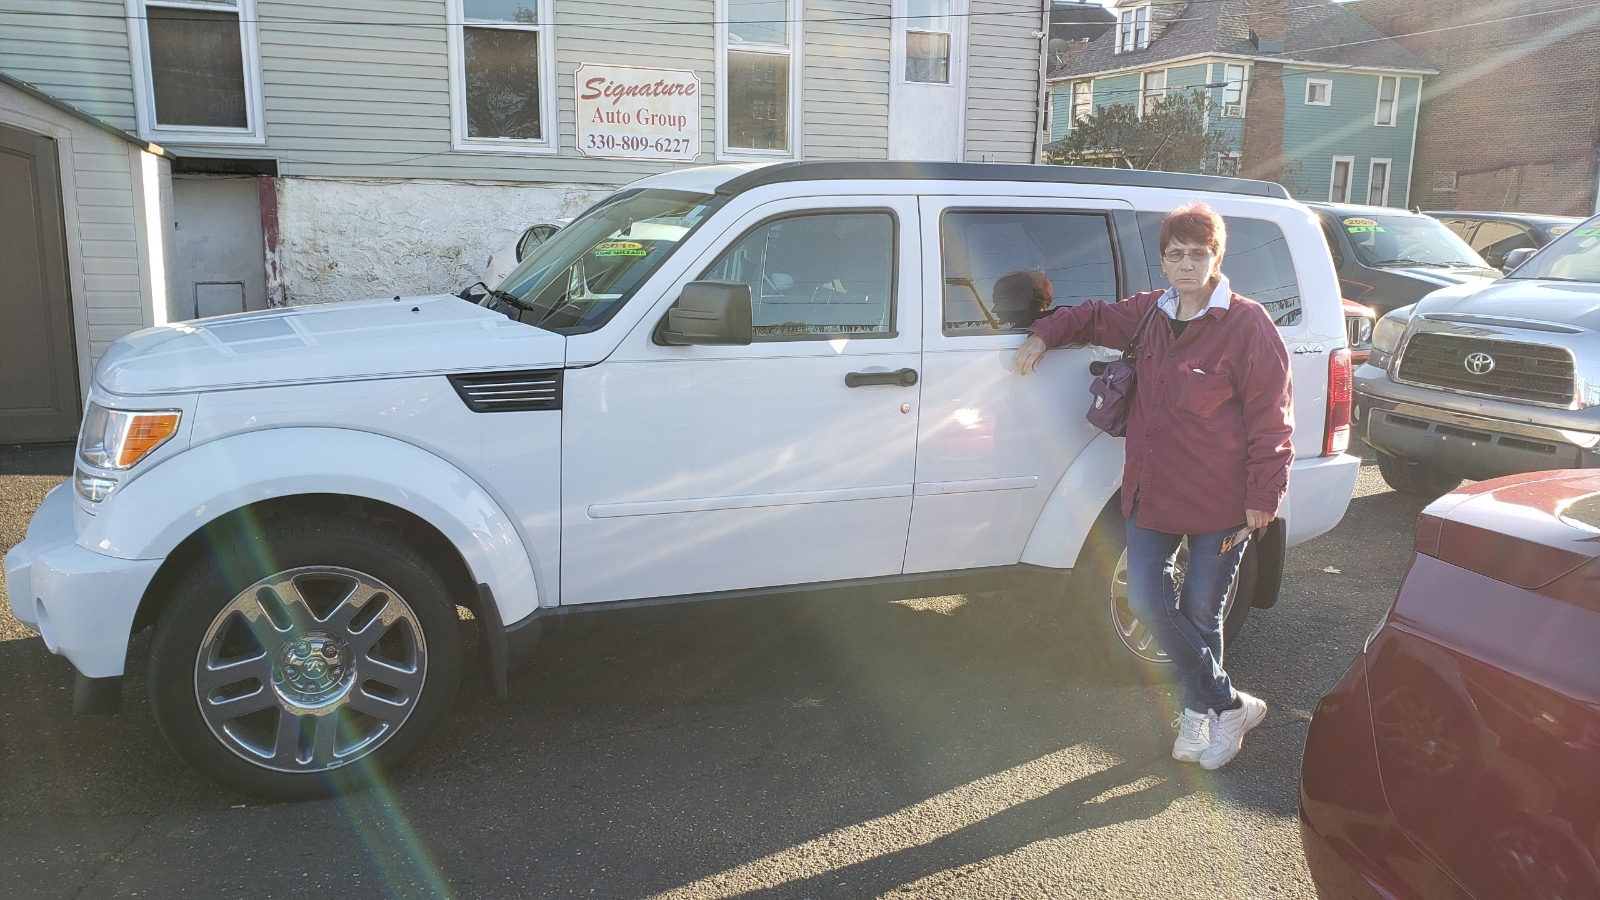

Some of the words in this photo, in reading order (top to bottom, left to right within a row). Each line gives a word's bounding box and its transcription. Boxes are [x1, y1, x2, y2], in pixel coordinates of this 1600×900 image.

[581, 77, 696, 105] Signature
[591, 106, 631, 124] Auto
[636, 108, 687, 131] Group
[587, 133, 690, 153] 330-809-6227
